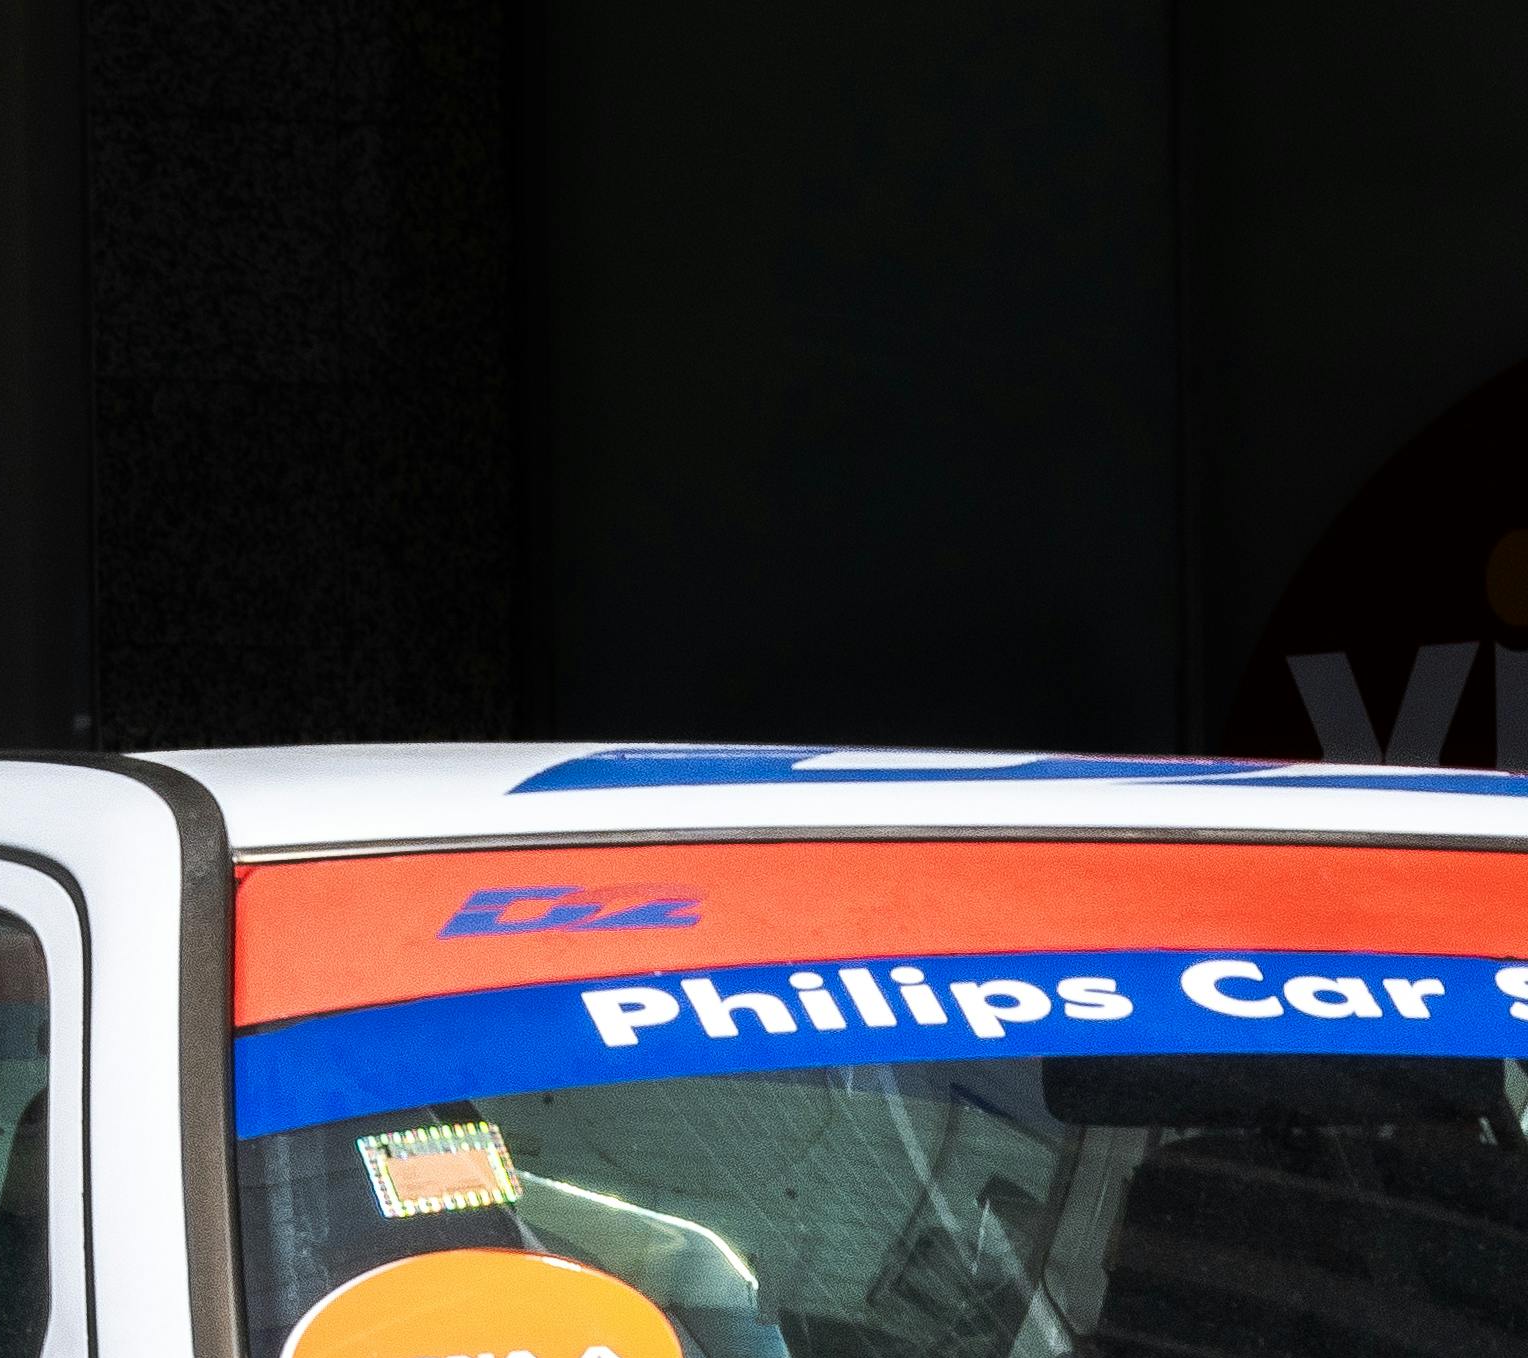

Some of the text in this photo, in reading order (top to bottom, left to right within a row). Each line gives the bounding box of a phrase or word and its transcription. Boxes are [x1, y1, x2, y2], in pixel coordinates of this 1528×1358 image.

[437, 885, 704, 940] D2
[580, 966, 1134, 1047] Philips
[1179, 958, 1446, 1021] Car
